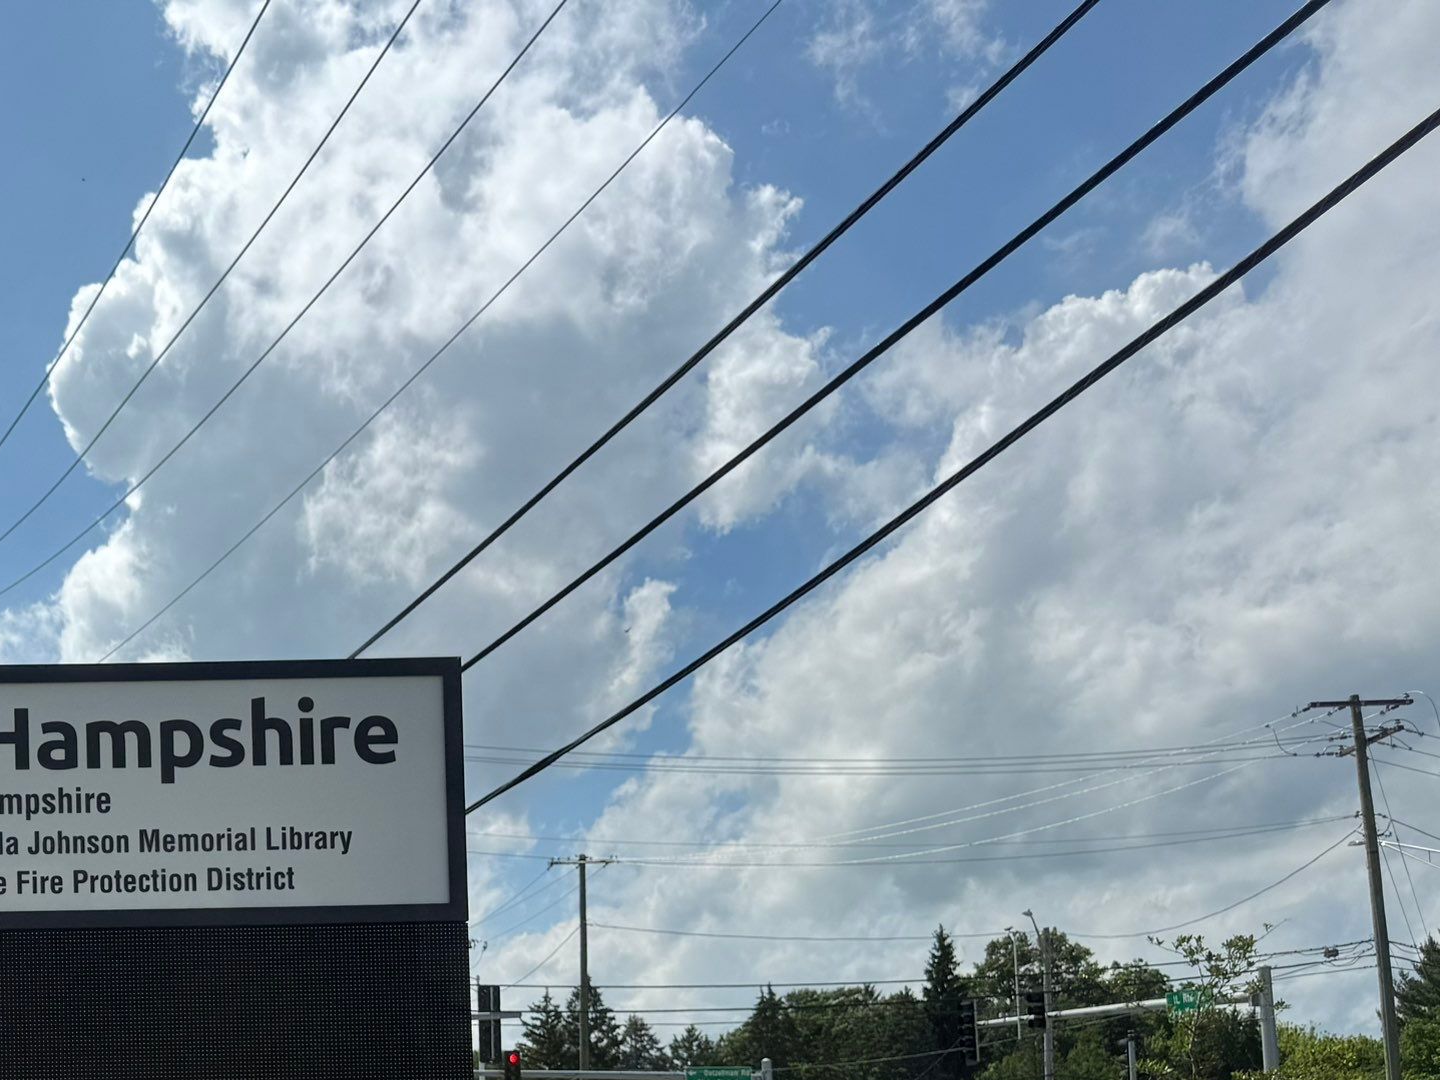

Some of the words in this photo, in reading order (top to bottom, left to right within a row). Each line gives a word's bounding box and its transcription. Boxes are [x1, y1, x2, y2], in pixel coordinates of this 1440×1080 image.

[28, 830, 129, 855] Johnson
[139, 827, 255, 853] Memorial
[266, 826, 352, 855] Library
[17, 871, 63, 895] Fire
[73, 869, 197, 894] Protection
[207, 866, 294, 891] District
